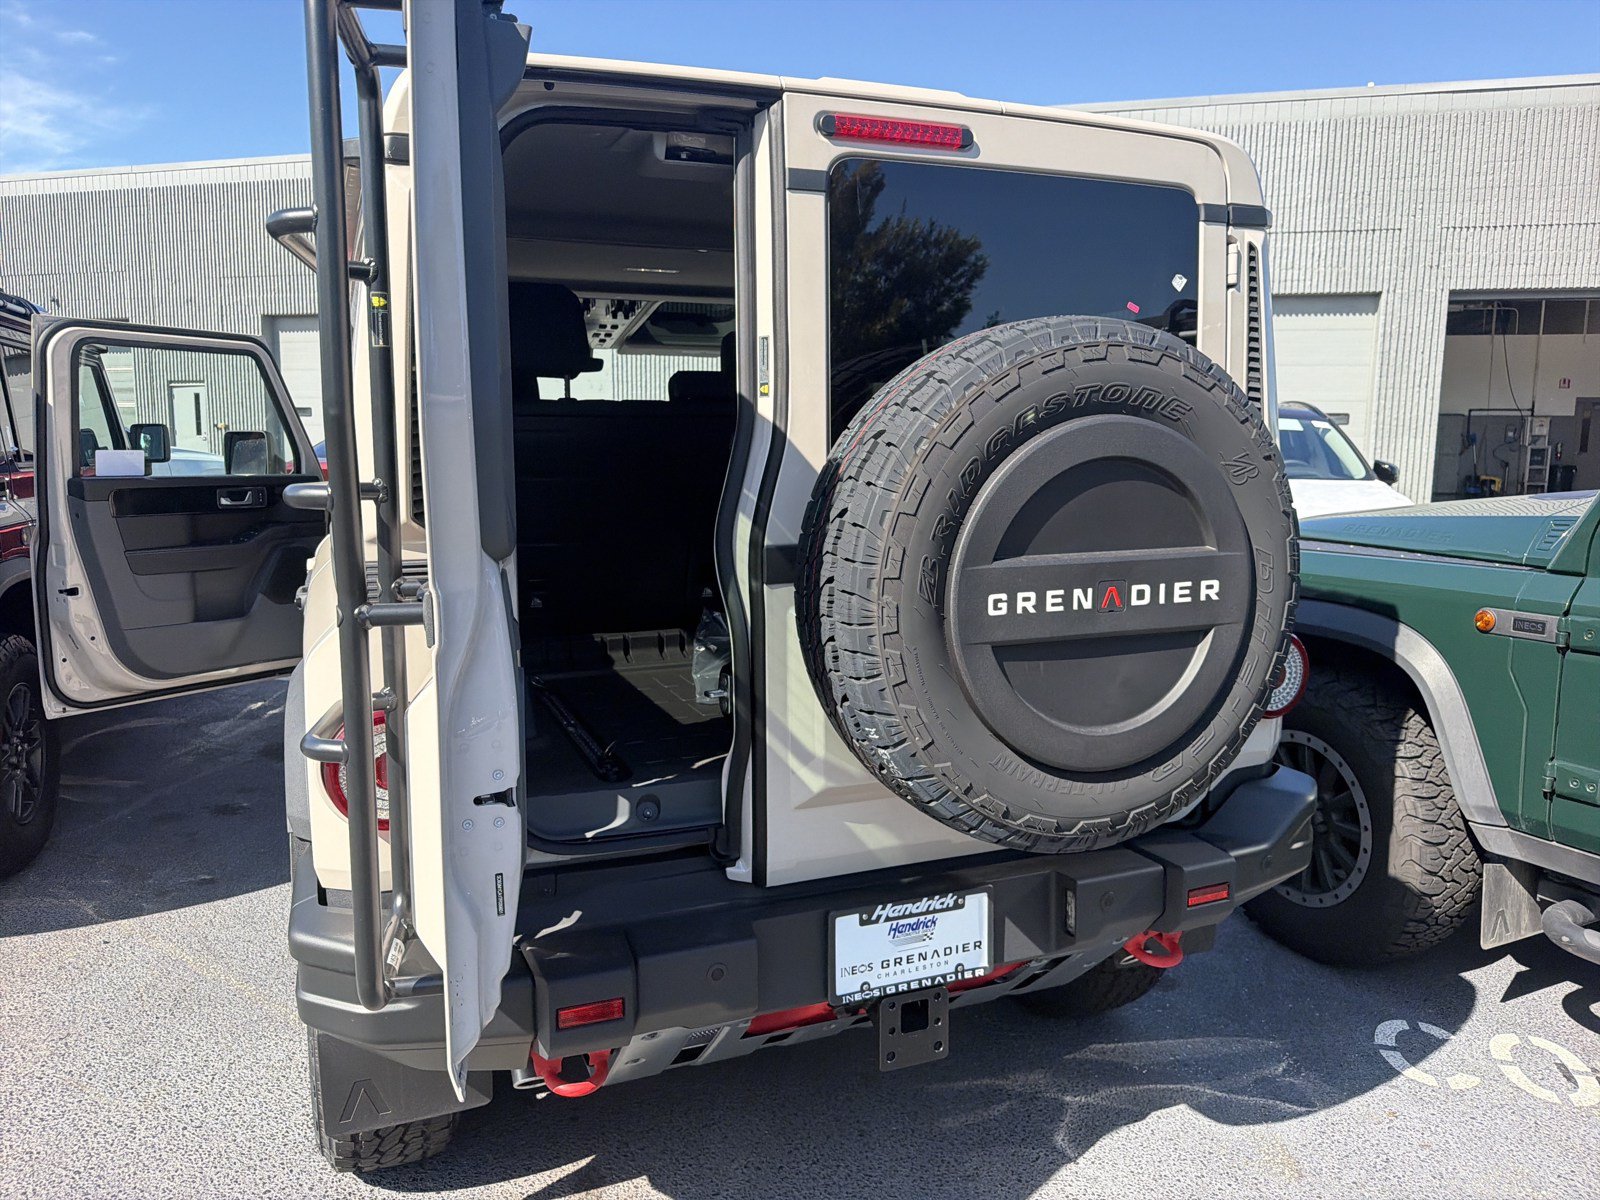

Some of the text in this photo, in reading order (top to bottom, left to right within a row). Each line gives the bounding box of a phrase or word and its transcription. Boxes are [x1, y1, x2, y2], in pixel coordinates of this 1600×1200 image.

[917, 382, 1193, 606] BRIDGESTONE
[987, 579, 1221, 616] GRENADIER
[1514, 620, 1544, 632] INEOS
[871, 893, 957, 924] Hendrick
[888, 915, 938, 939] Hendrick
[840, 940, 982, 978] INEOS GRENADIER
[877, 960, 949, 979] CHARLESTON
[842, 968, 985, 1004] INEOS GRENADIER
